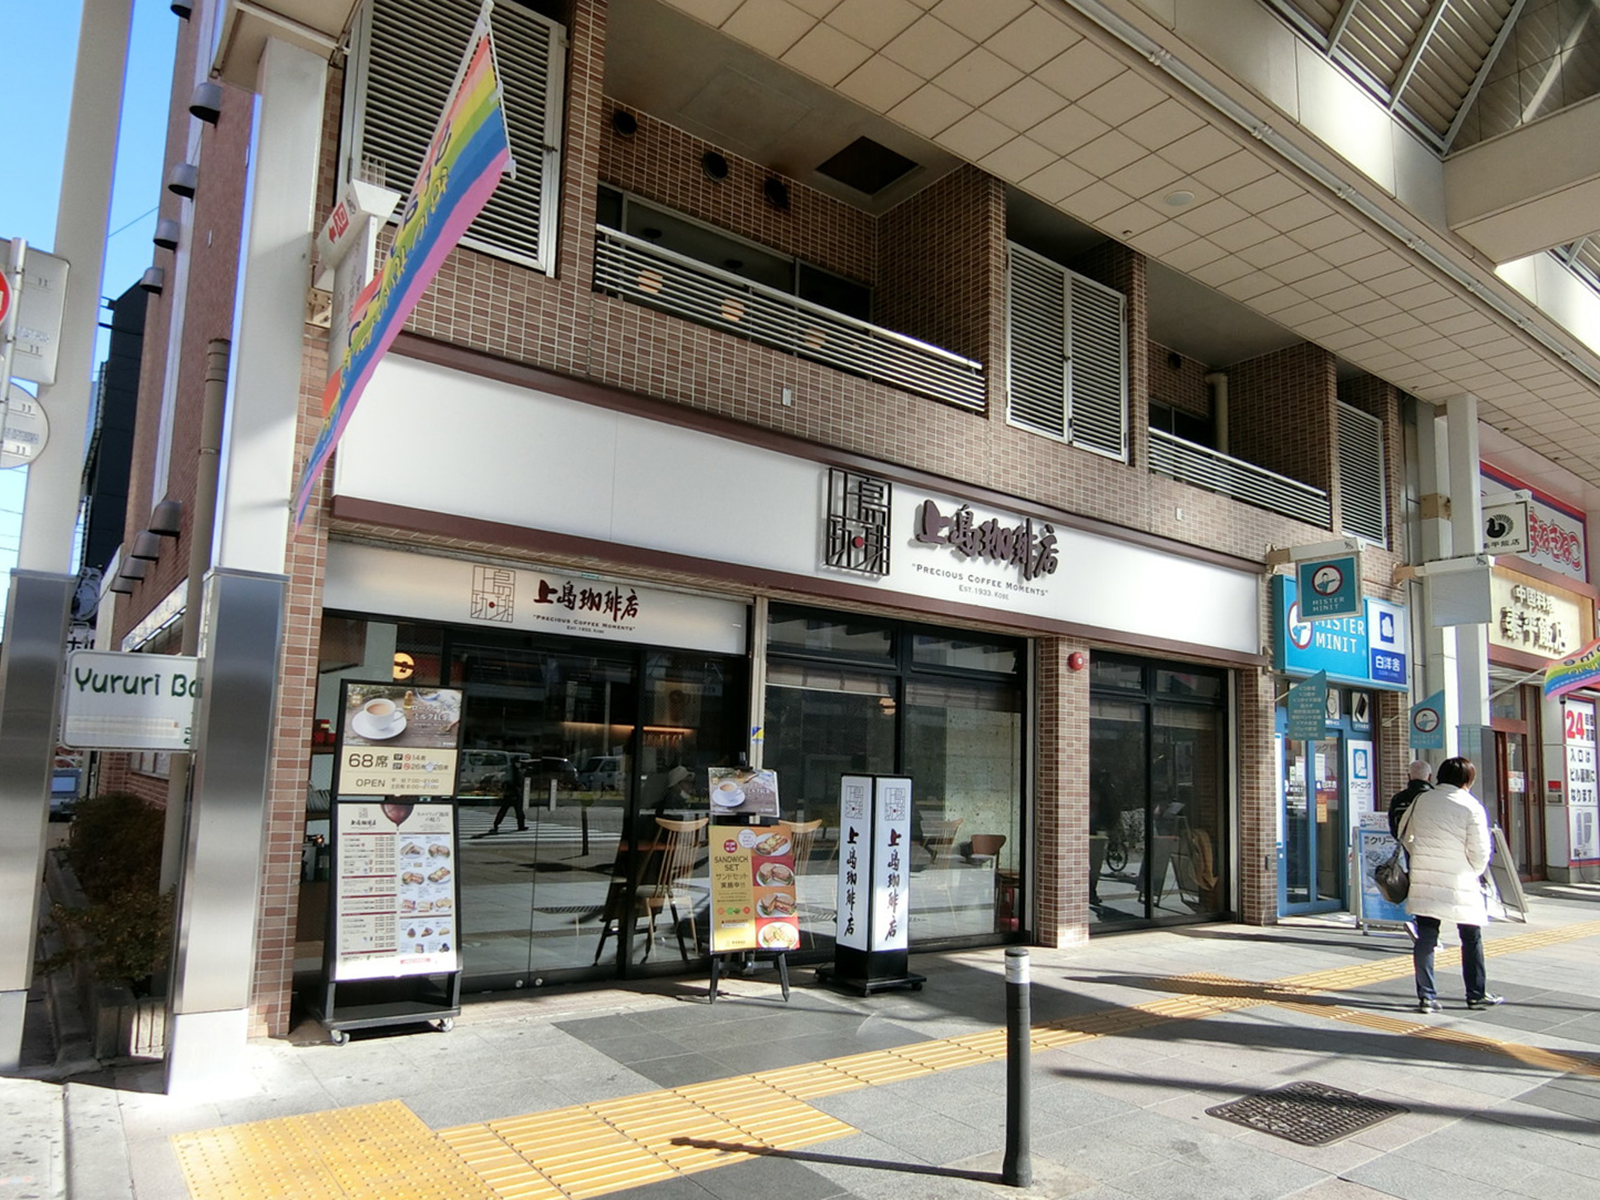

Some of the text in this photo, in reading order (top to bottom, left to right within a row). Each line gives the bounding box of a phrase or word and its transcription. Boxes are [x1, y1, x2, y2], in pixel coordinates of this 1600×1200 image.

[915, 498, 1060, 581] 上島珈琲店
[967, 574, 1002, 588] COFFEE
[533, 578, 640, 622] 上島珈琲店
[1312, 596, 1345, 606] MISTER
[1312, 604, 1339, 612] MINIT
[573, 619, 599, 627] COFFEE
[1315, 631, 1357, 653] MINIT
[75, 667, 160, 696] Yururi
[1566, 710, 1585, 740] 24
[349, 753, 389, 768] 68席
[355, 778, 386, 788] OPEN
[714, 855, 748, 864] SANDWICH
[724, 863, 740, 871] SET
[844, 826, 860, 937] 上島珈琲店
[884, 828, 902, 941] 上島珈琲店
